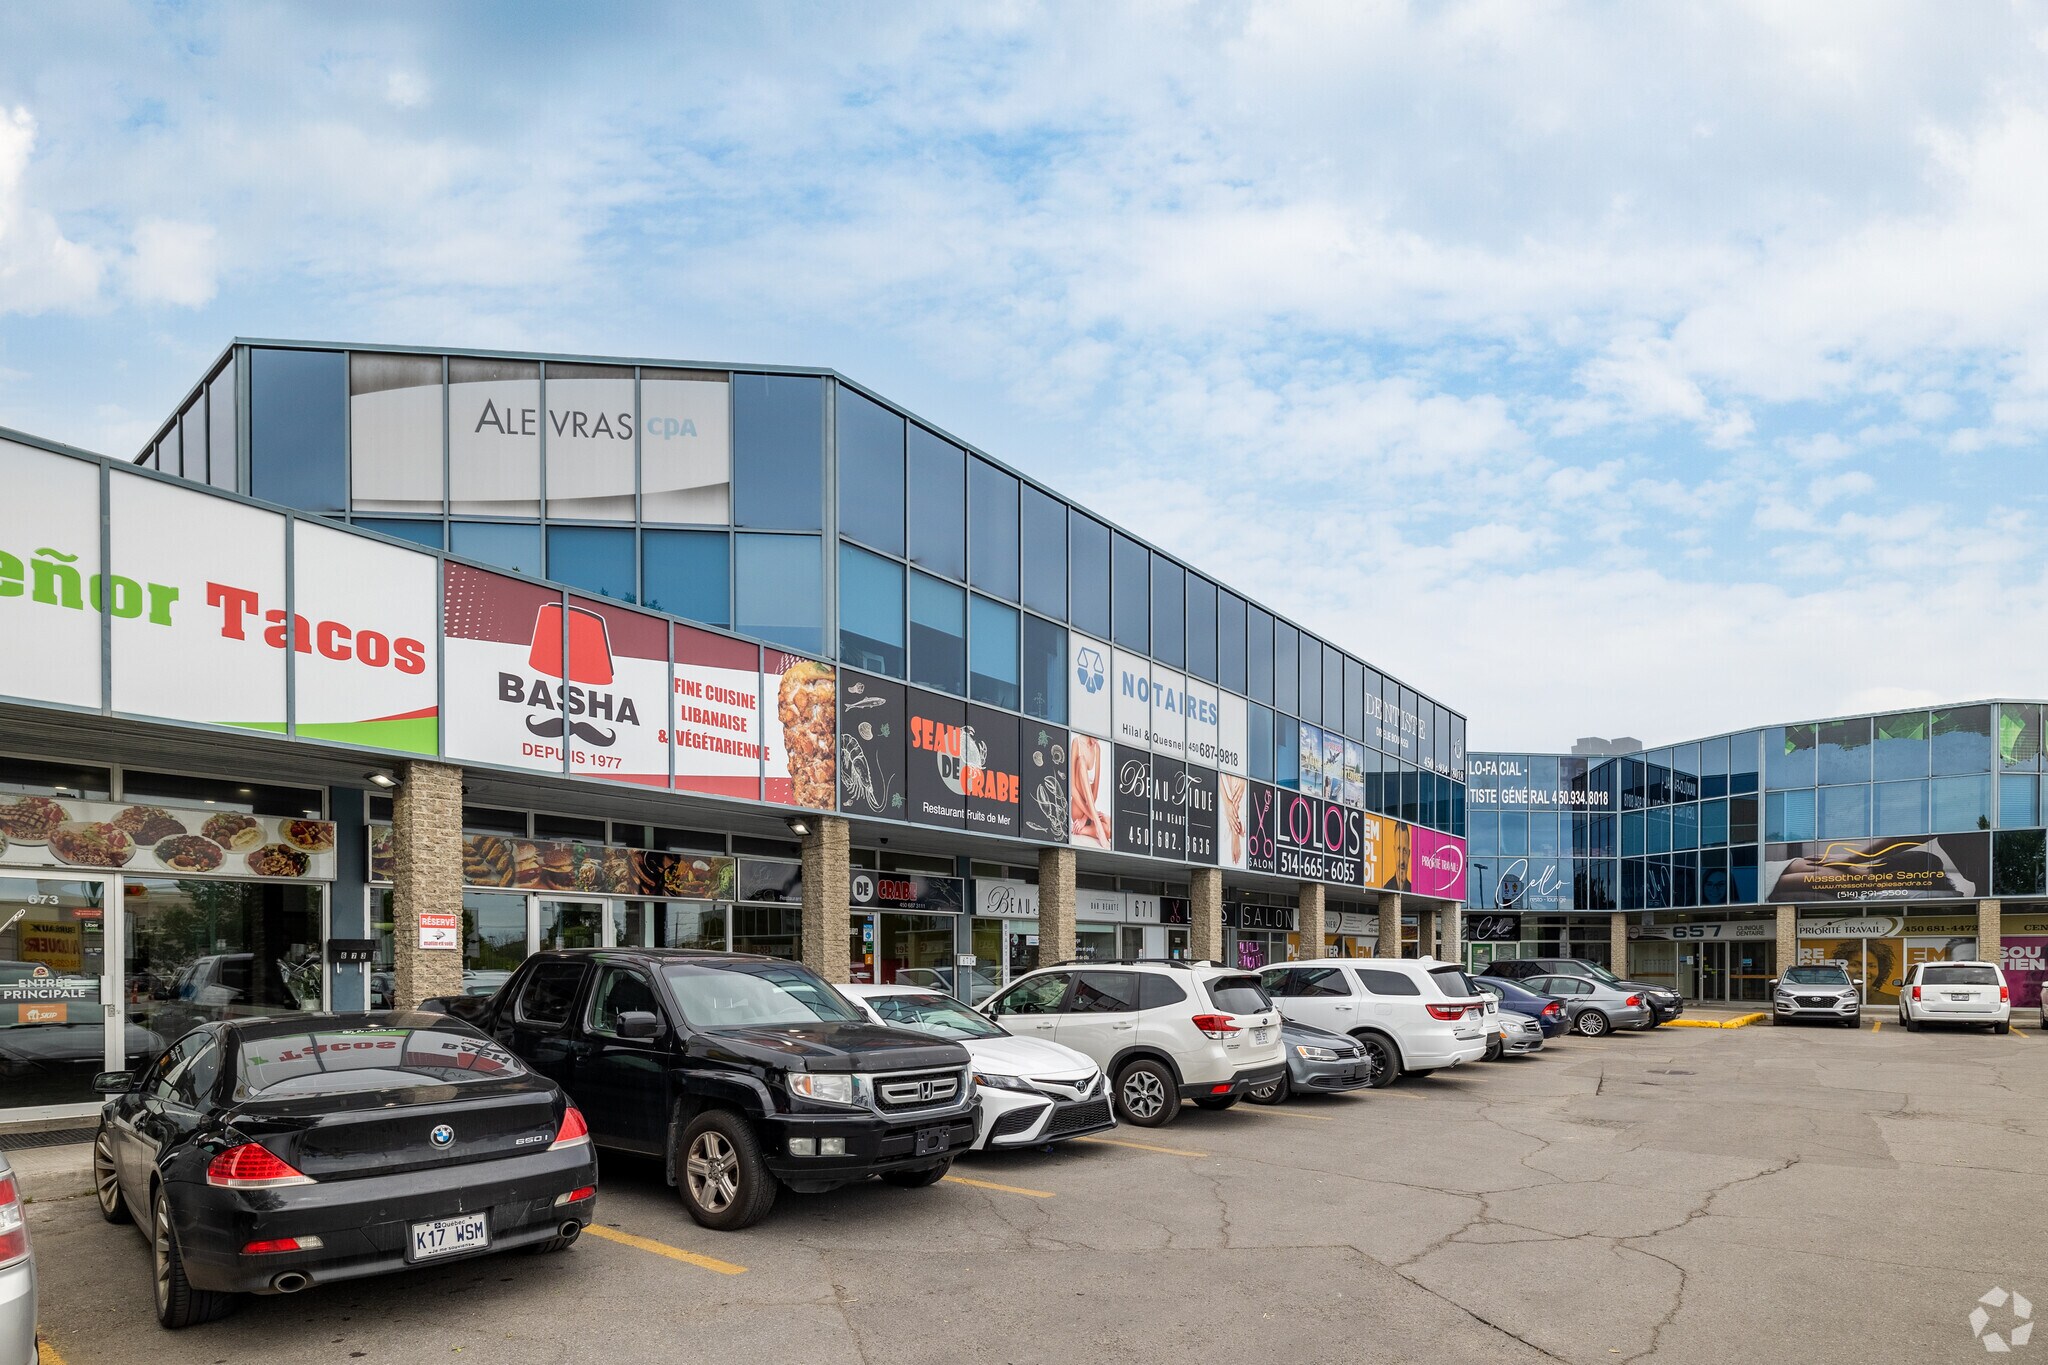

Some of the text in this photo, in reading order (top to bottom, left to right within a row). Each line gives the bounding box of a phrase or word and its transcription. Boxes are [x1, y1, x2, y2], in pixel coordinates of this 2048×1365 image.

[206, 581, 426, 676] Tacos
[498, 671, 641, 727] BASHA
[674, 678, 756, 711] FINE CUISINE
[1122, 671, 1217, 726] NOTAIRES
[681, 705, 748, 733] LIBANAISE
[1365, 692, 1426, 740] DENTISTE
[658, 729, 771, 762] & VÉGÉTARIENNE
[910, 715, 961, 757] SEAU
[1122, 723, 1142, 738] Hilal
[1144, 730, 1150, 741] &
[1153, 733, 1184, 751] Quesnel
[522, 742, 622, 769] DEPUIS 1977
[941, 754, 960, 781] DE
[960, 764, 1020, 804] CRABE
[1501, 785, 1550, 804] GÉNÉRAL
[922, 801, 965, 819] Restaurant
[986, 812, 997, 824] de
[997, 814, 1011, 826] Mer
[1277, 790, 1360, 855] LOLO'S
[1249, 857, 1274, 870] SALON
[1896, 870, 1945, 880] Sandra
[856, 879, 918, 901] DE CRABE
[1495, 858, 1571, 907] Cello
[1837, 889, 1909, 899] (514) 291-5500
[27, 894, 60, 905] 673
[1134, 900, 1153, 918] 671
[421, 916, 456, 927] RÉSERVÉ
[1243, 906, 1293, 928] SALON
[1903, 924, 1979, 933] 450 681-4472
[1672, 924, 1722, 939] 657
[1799, 925, 1841, 936] PRIORITÉ
[1844, 926, 1881, 934] TRAVAIL
[1800, 947, 1825, 959] RE
[1999, 958, 2046, 971] TIEN
[3, 989, 86, 999] PRINCIPALE
[441, 1219, 466, 1228] Québec
[416, 1221, 484, 1250] K17 WSM
